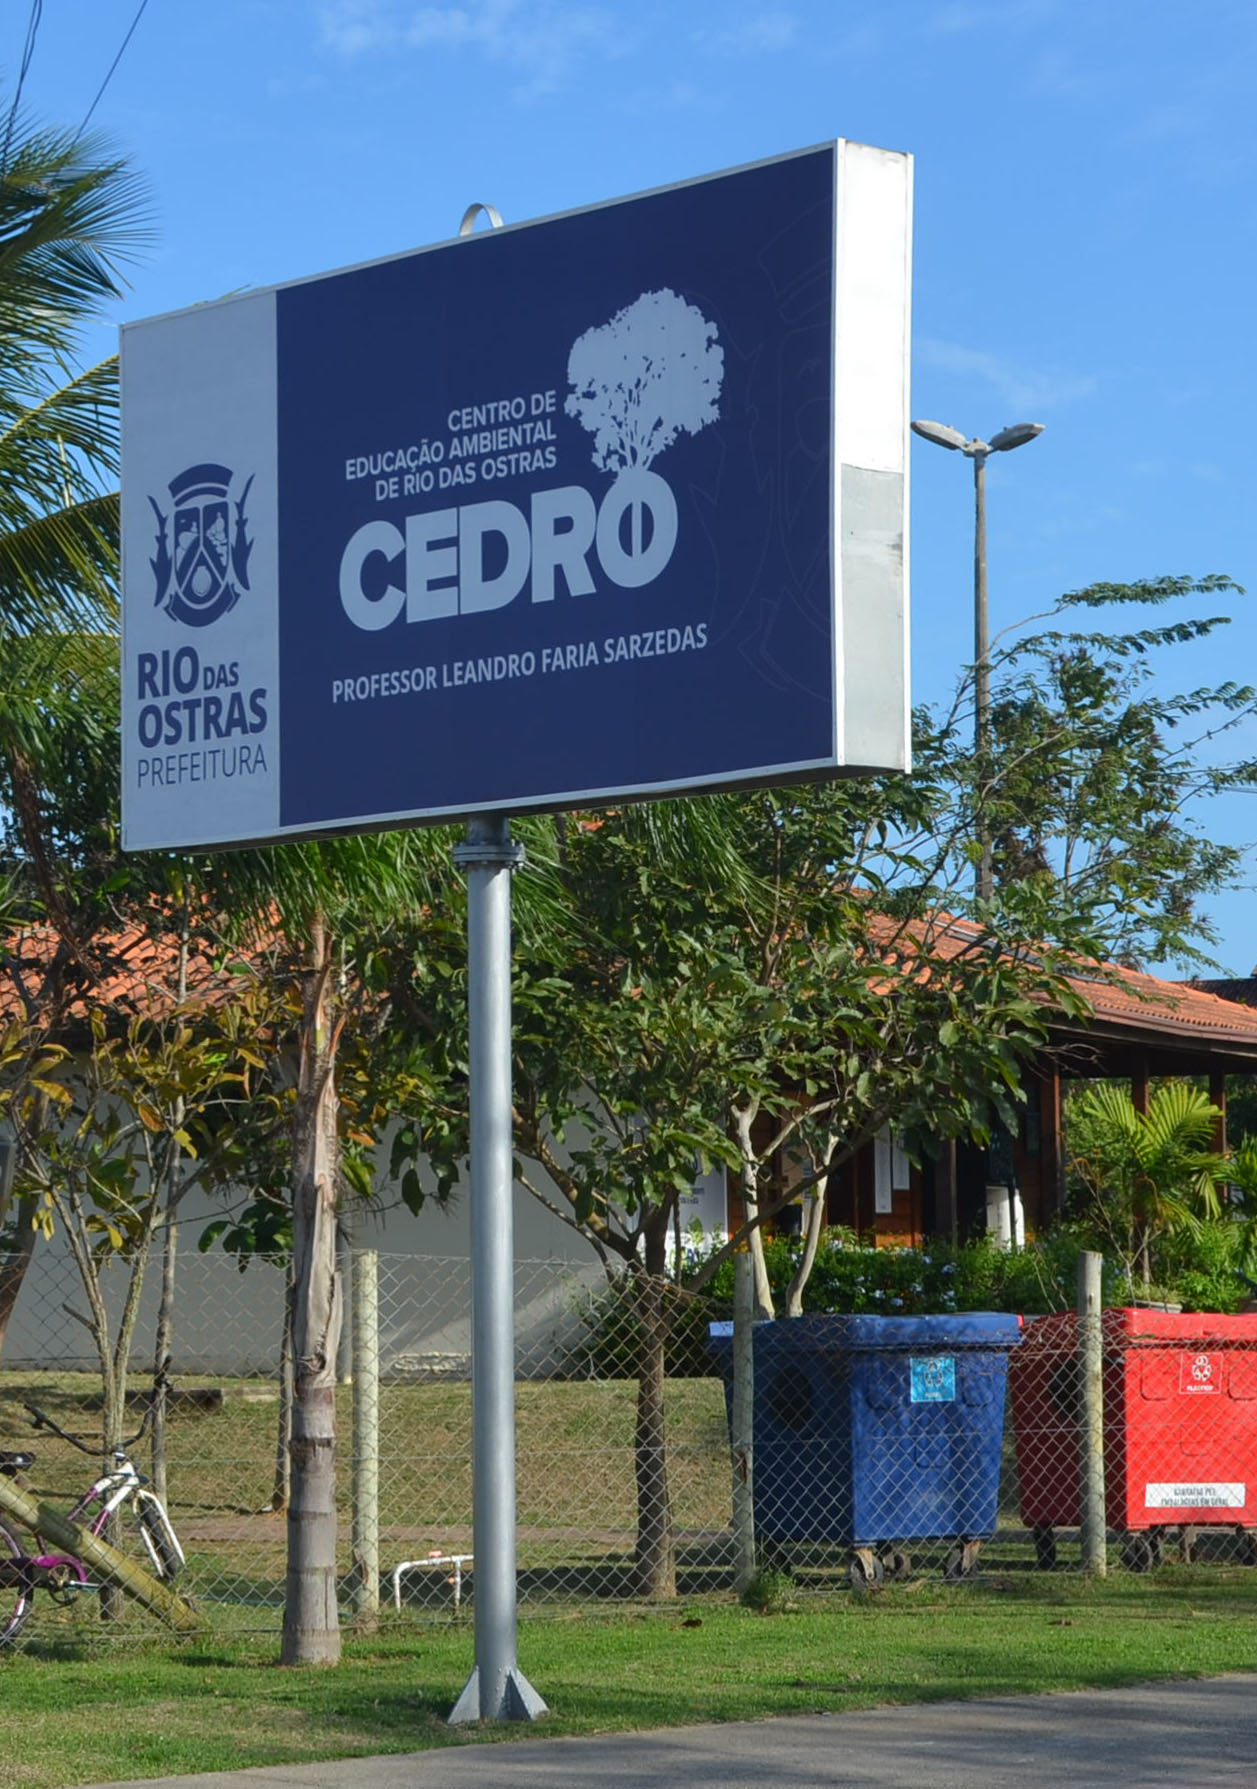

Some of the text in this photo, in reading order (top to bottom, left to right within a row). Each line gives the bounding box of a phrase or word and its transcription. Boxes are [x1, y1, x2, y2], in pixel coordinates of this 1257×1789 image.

[447, 390, 557, 432] CENTRO DE
[345, 418, 557, 480] EDUCAÇÃO AMBIENTAL
[375, 446, 557, 501] DE RIO DAS OSTRAS
[339, 469, 679, 632] CEDRO
[137, 645, 240, 701] RIO DAS
[332, 622, 708, 704] PROFESSOR LEANDRO FARIA SARZEDAS
[138, 687, 268, 749] OSTRAS
[137, 743, 268, 789] PREFEITURA
